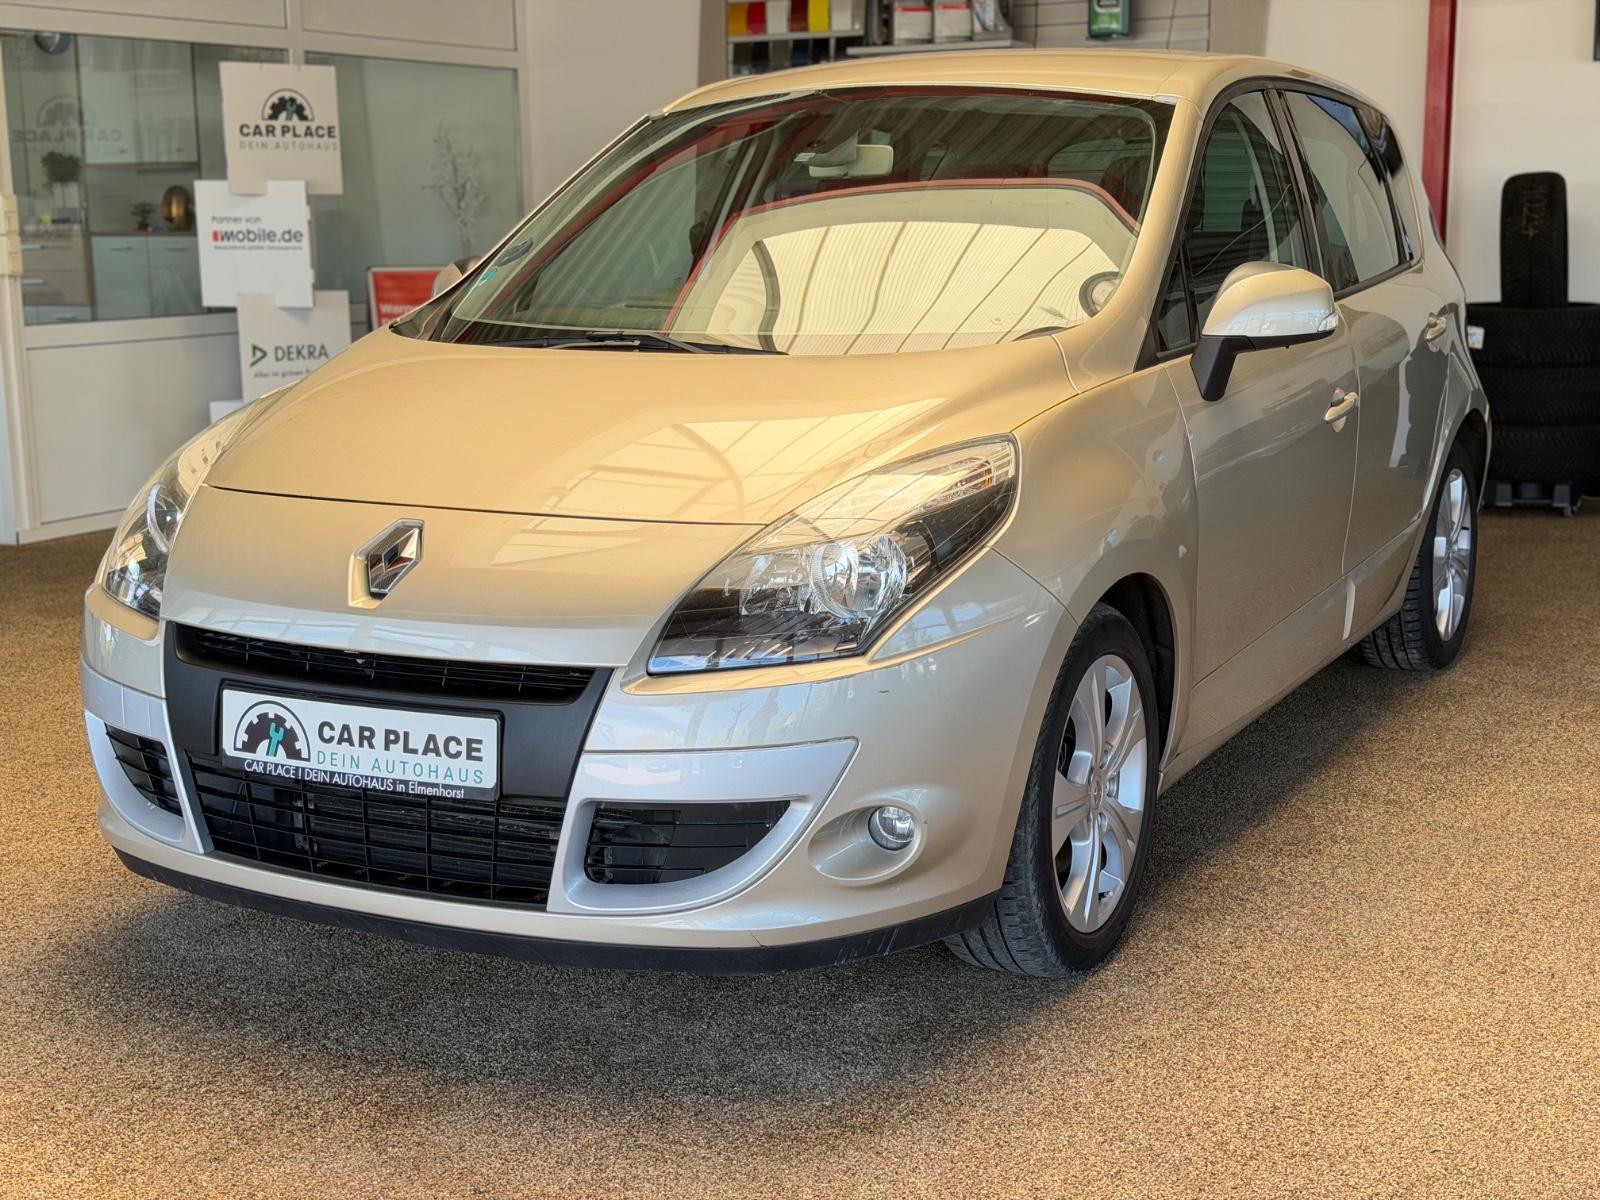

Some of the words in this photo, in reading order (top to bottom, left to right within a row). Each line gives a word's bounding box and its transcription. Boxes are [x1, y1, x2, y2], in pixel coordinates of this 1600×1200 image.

[239, 124, 276, 137] CAR
[281, 125, 337, 138] PLACE
[239, 141, 269, 150] DEIN
[274, 142, 338, 151] AUTOHAUS
[211, 215, 243, 224] Partner
[274, 344, 329, 362] DEKRA
[317, 721, 376, 750] CAR
[384, 729, 484, 762] PLACE
[316, 751, 360, 769] DEIN
[371, 758, 483, 784] AUTOHAUS
[244, 760, 264, 772] CAR
[266, 763, 295, 779] PLACE
[304, 769, 330, 784] DEIN
[332, 774, 393, 792] AUTOHAUS
[396, 781, 405, 792] in
[408, 781, 465, 799] Elmenhorst
